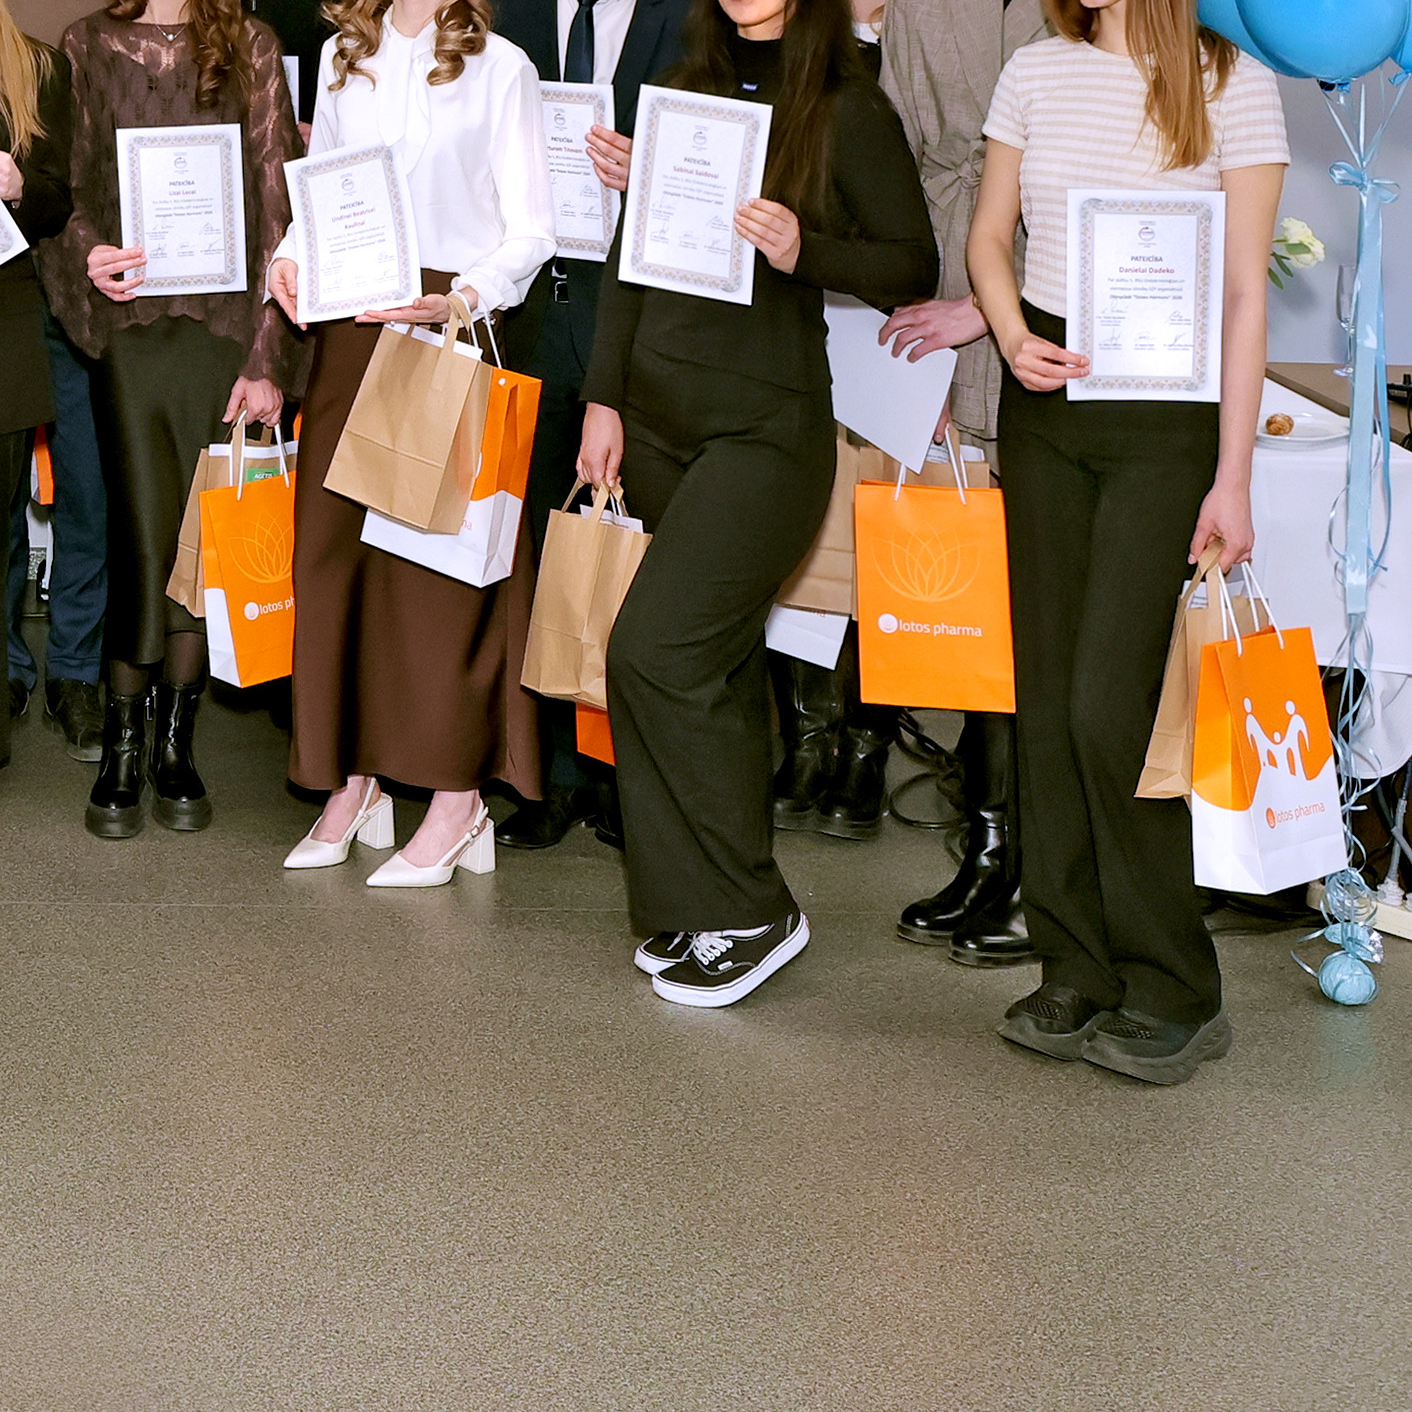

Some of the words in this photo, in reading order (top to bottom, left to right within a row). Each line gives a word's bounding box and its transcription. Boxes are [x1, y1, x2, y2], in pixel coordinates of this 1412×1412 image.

[259, 601, 283, 615] lotos
[899, 619, 931, 633] lotos
[933, 621, 983, 637] pharma
[1295, 802, 1325, 821] pharma
